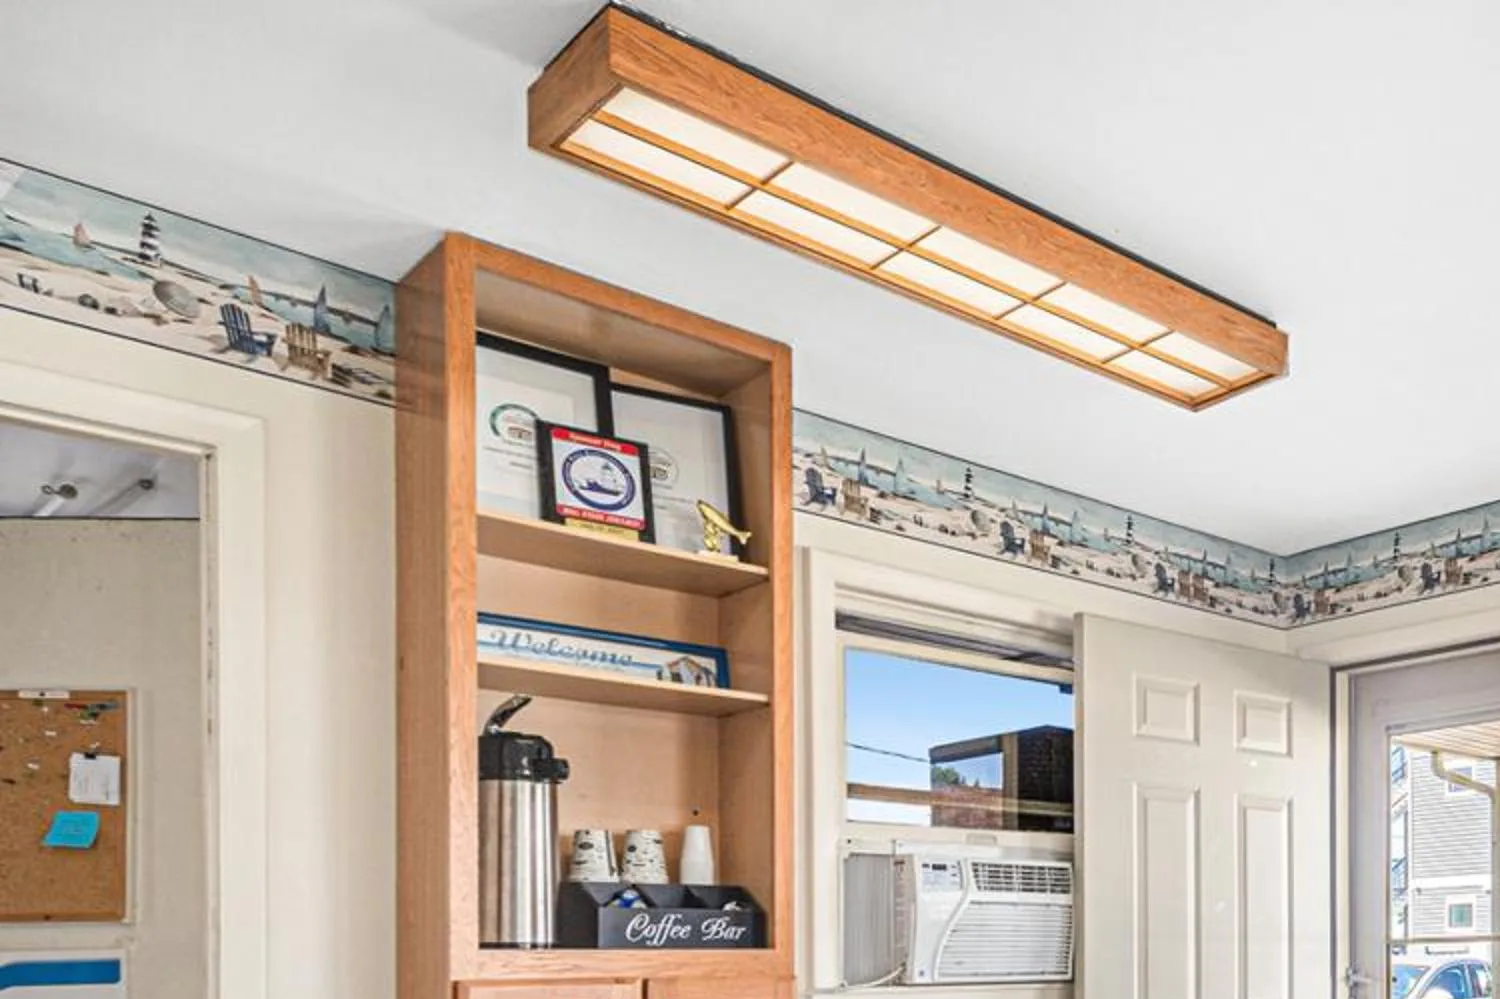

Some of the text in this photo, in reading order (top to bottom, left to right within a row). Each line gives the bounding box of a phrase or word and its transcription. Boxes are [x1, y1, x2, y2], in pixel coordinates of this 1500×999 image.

[489, 629, 634, 667] Welcome
[624, 912, 747, 947] Coffee Bar
